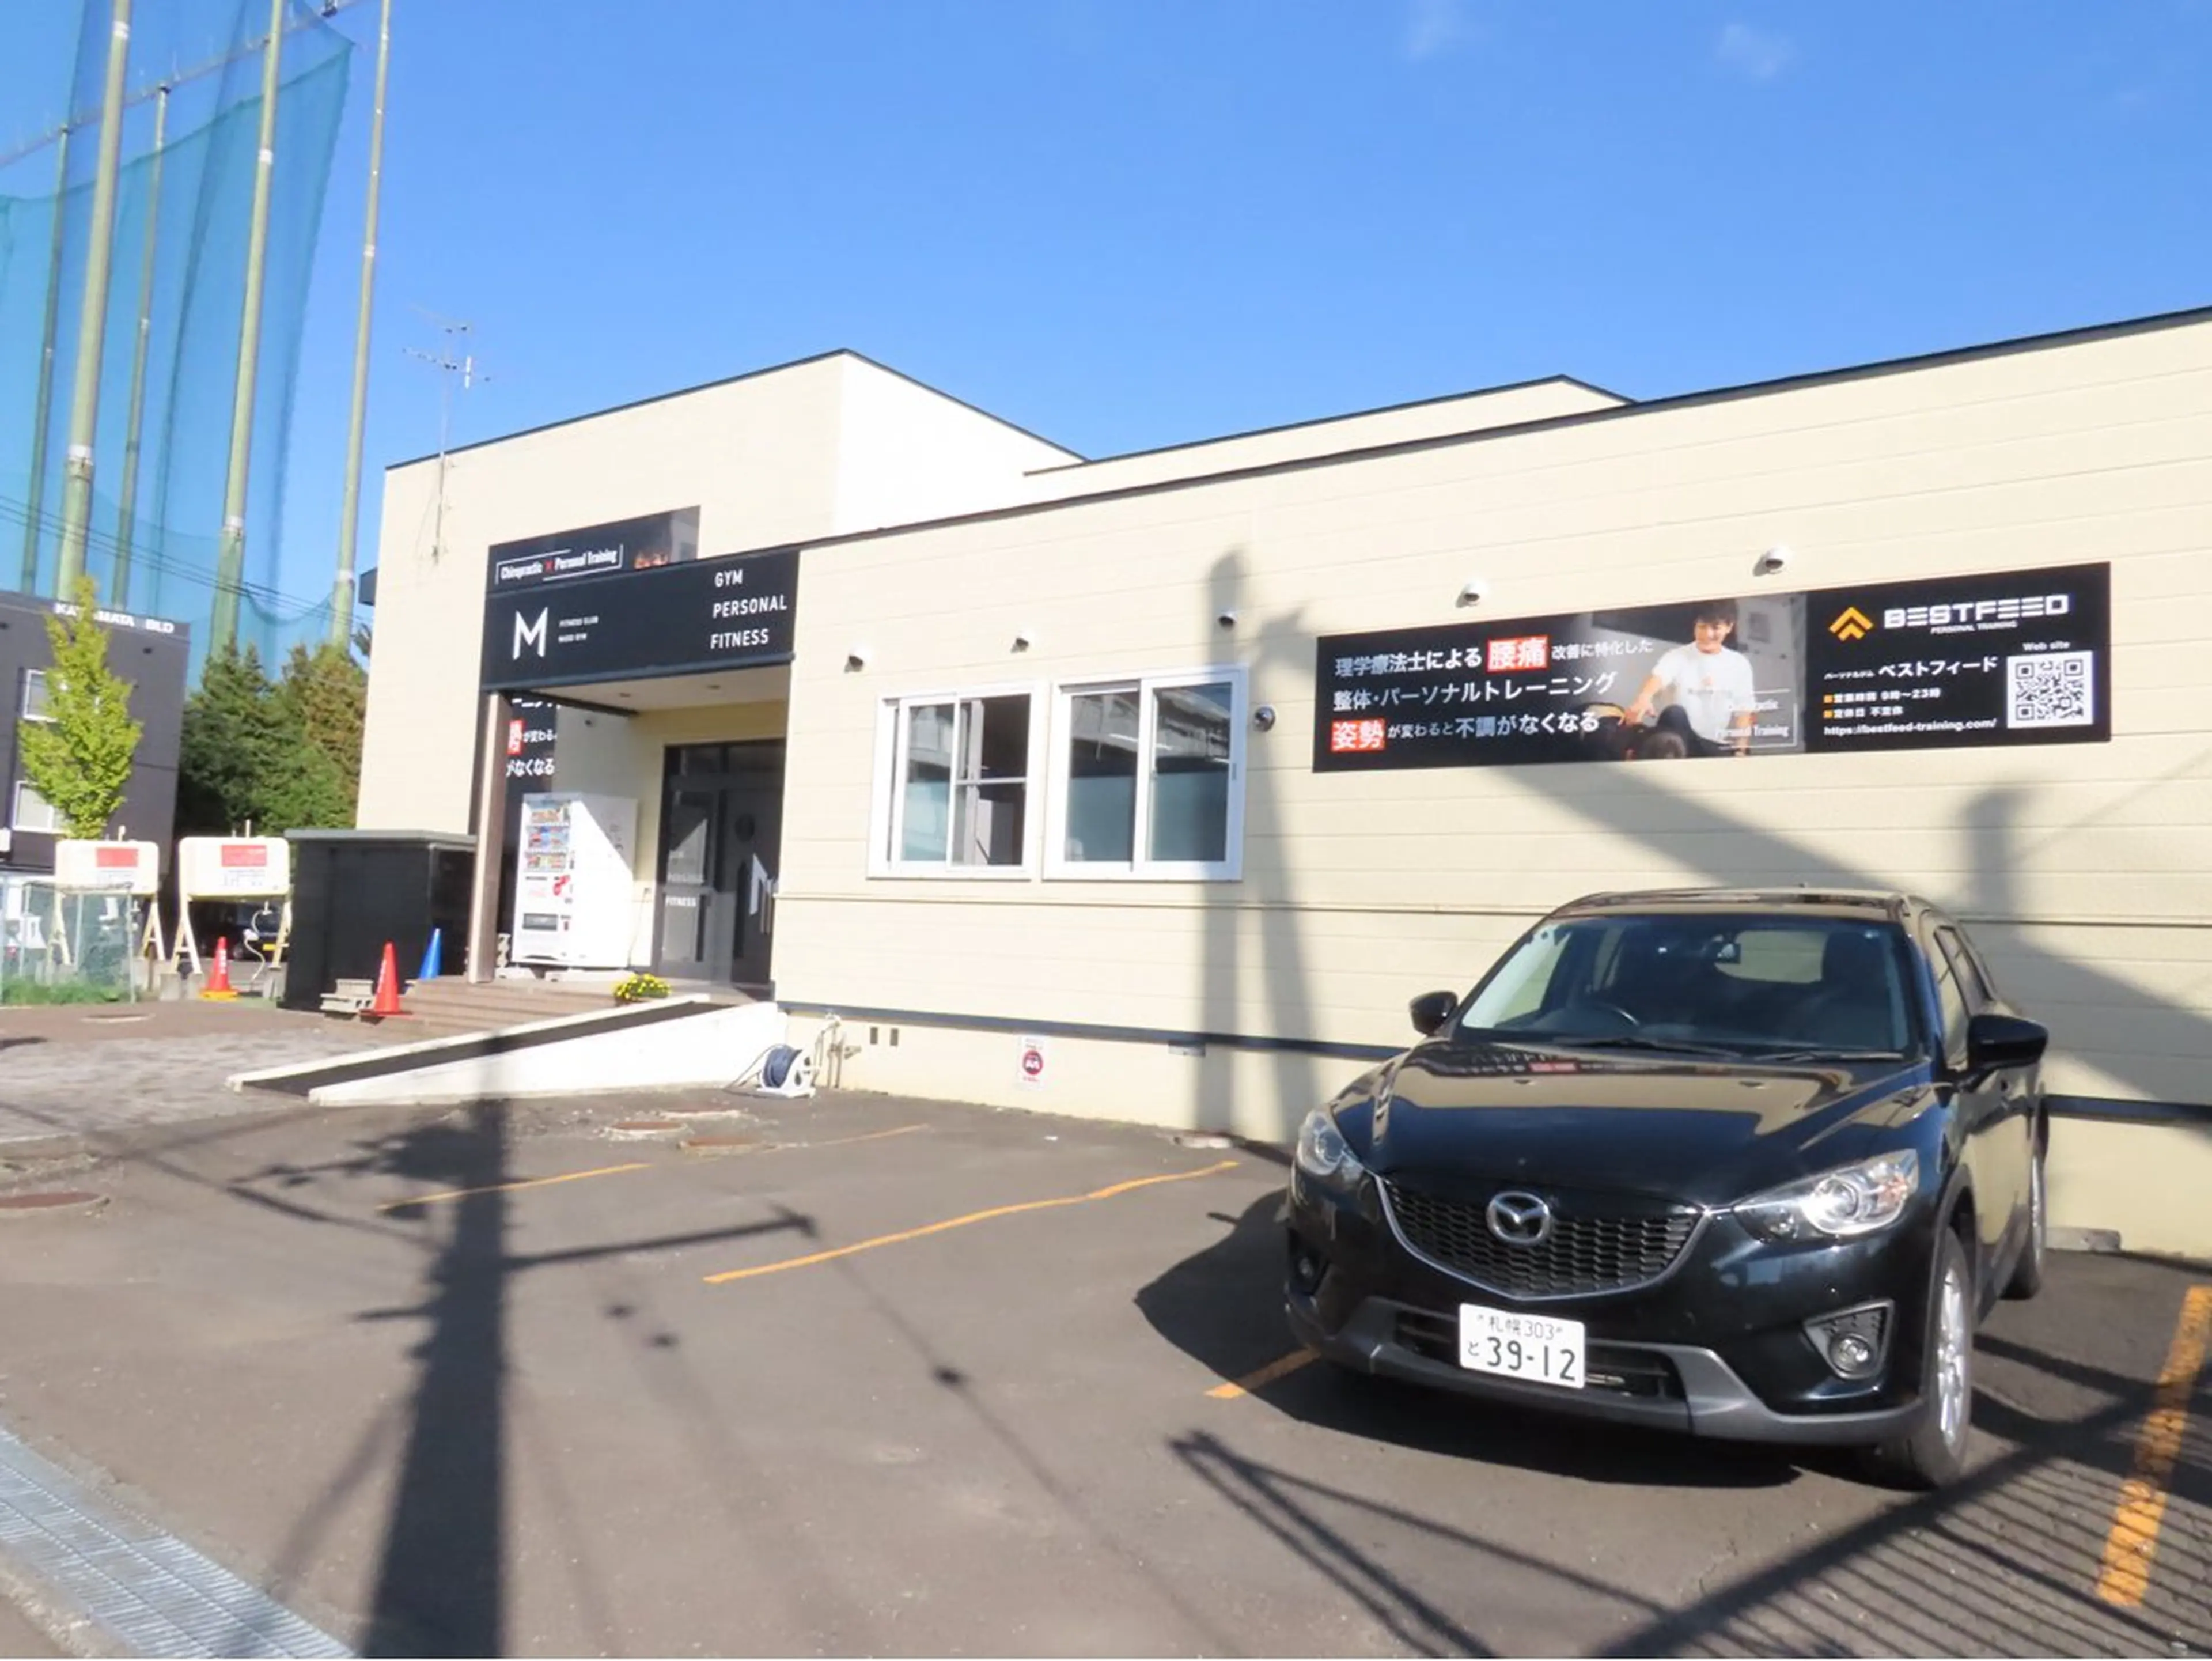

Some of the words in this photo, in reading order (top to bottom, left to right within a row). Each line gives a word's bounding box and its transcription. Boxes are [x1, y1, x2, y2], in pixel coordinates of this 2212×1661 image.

[555, 551, 586, 572] Personal
[588, 549, 618, 566] Training
[714, 569, 743, 587] GYM
[713, 594, 787, 619] PERSONAL
[1884, 594, 2070, 629] BESTFEED
[512, 607, 548, 661] M
[710, 628, 769, 649] FITNESS
[2023, 641, 2047, 652] Web
[2050, 640, 2070, 649] site
[1878, 656, 1998, 678] ベストフィード
[1824, 718, 1997, 736] https://bestfeed-training.com/
[665, 896, 696, 908] FITNESS
[1486, 1336, 1576, 1382] 39-12
